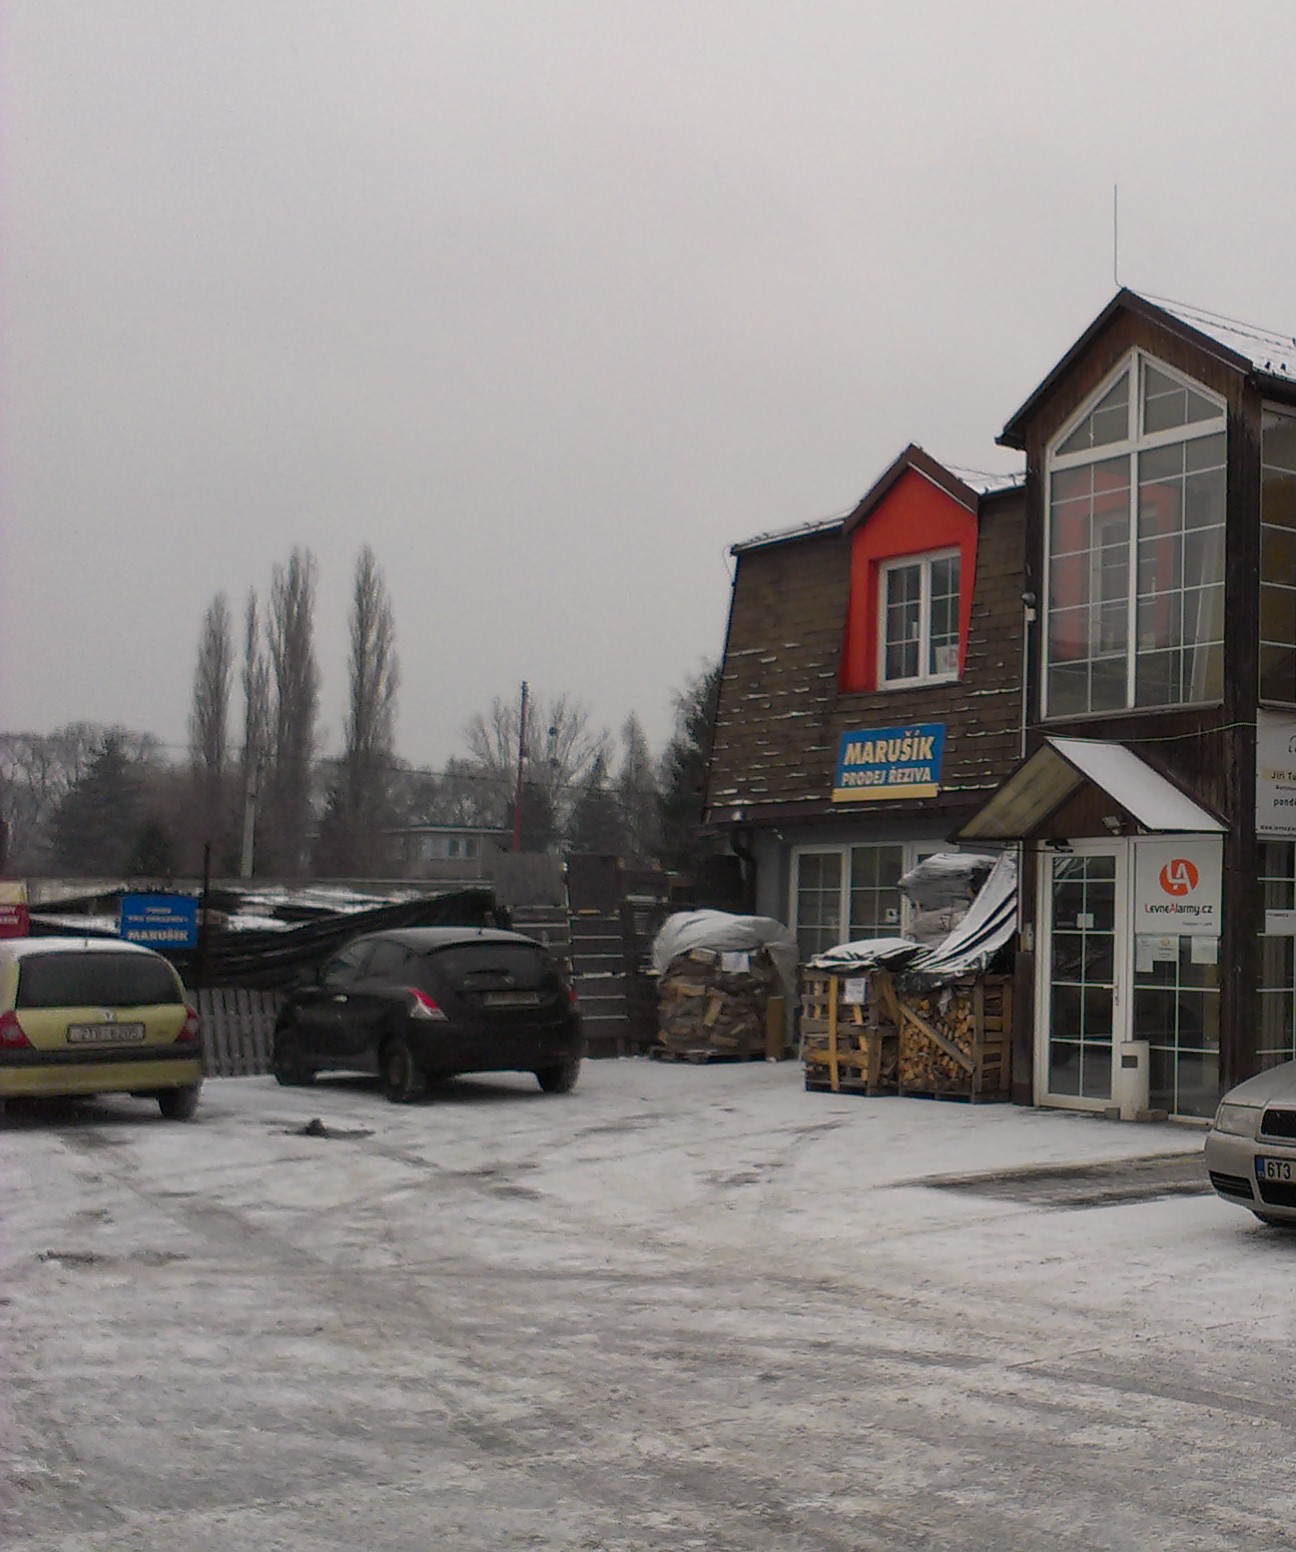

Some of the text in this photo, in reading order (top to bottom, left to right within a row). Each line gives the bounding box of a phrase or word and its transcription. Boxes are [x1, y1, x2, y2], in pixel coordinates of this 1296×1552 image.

[843, 729, 935, 766] MARUŠÍK
[841, 766, 932, 786] PRODEJ ŘEZIVA
[1144, 903, 1213, 916] LevneAlarmy.cz
[1267, 1161, 1291, 1180] 6T3
